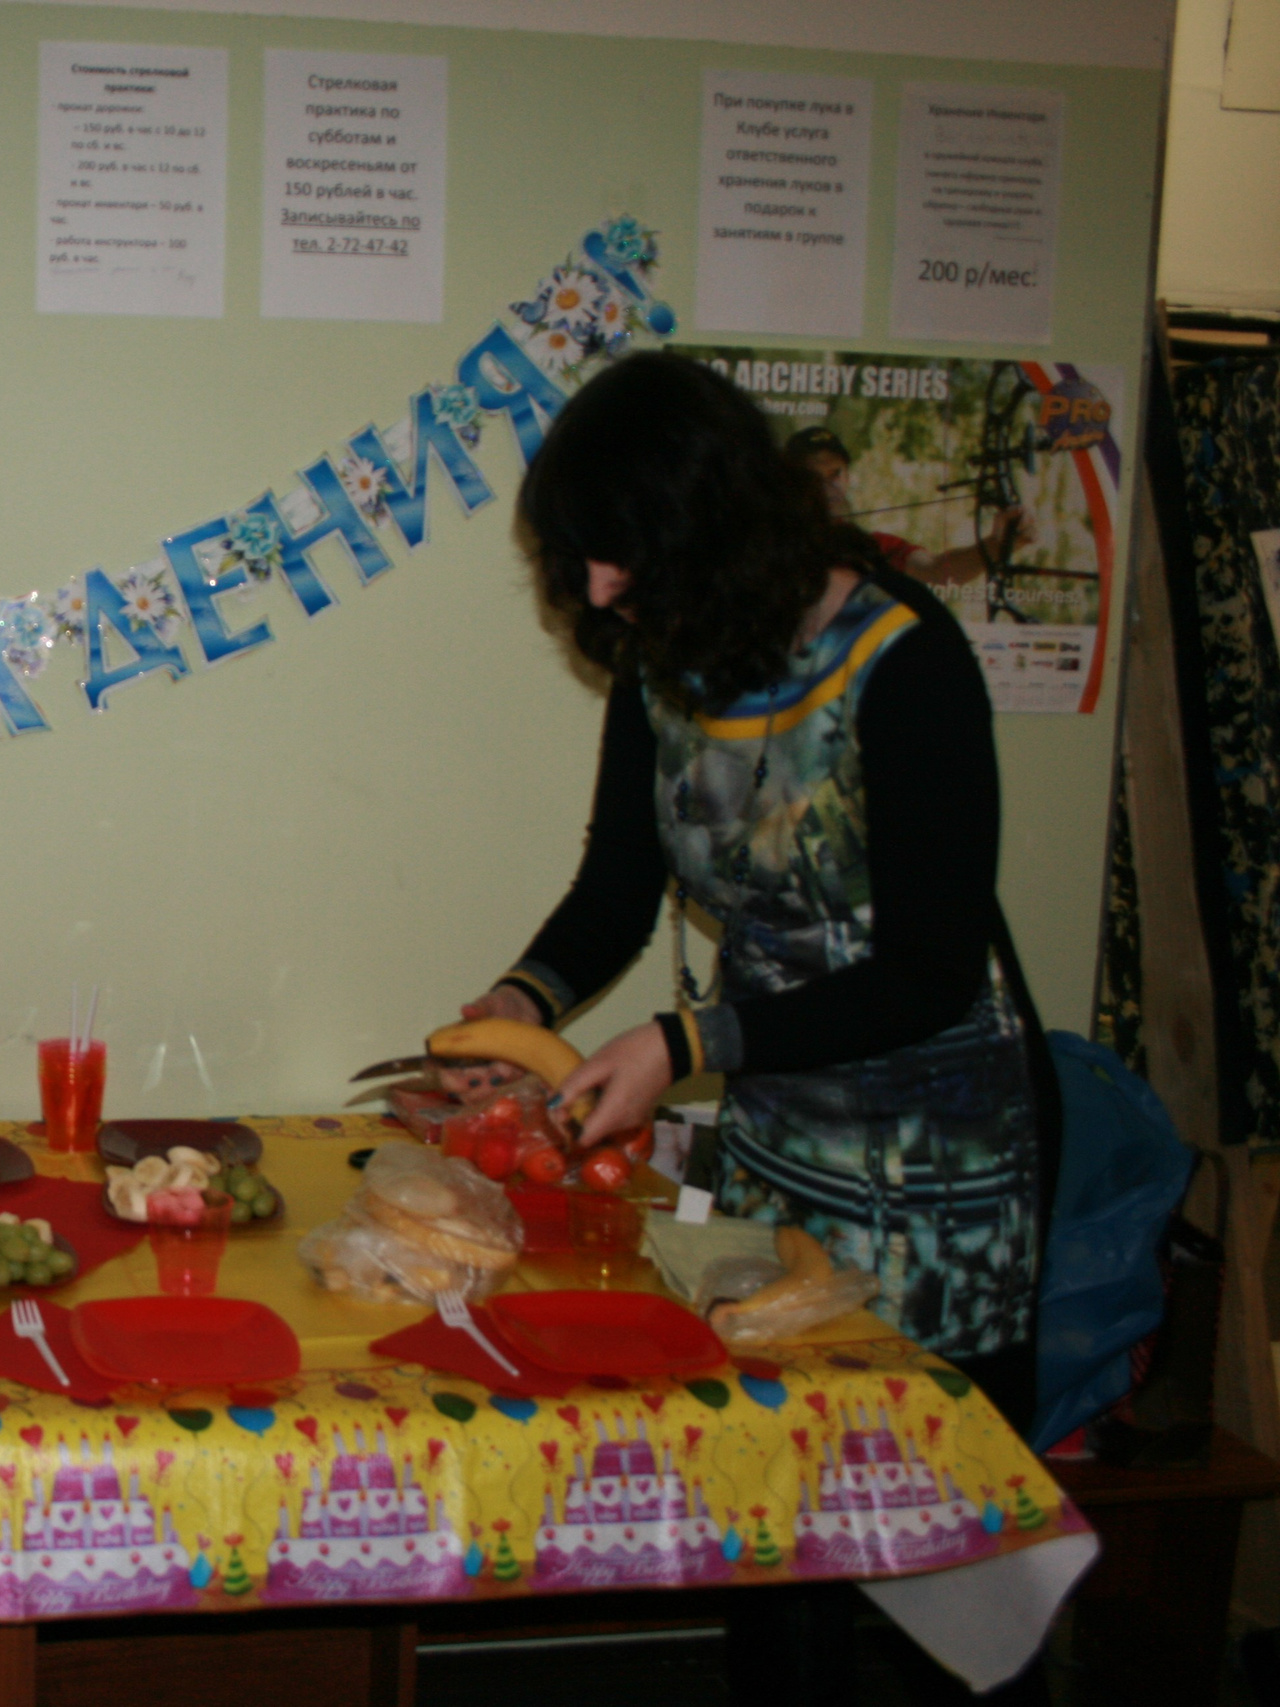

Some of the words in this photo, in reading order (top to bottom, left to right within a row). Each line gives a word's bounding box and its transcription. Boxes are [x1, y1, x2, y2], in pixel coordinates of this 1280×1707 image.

[307, 73, 399, 92] Стрелковая
[305, 103, 377, 119] практика
[381, 105, 401, 119] по
[713, 91, 743, 110] При
[745, 96, 807, 113] покупке
[810, 101, 842, 116] лука
[845, 104, 855, 115] в
[83, 123, 101, 133] 150
[193, 126, 206, 137] 12
[307, 128, 383, 147] субботам
[387, 134, 397, 146] и
[736, 120, 780, 138] Клубе
[784, 126, 830, 141] услуга
[78, 160, 96, 170] 200
[158, 162, 170, 172] 12
[285, 157, 396, 174] воскресеньям
[400, 161, 418, 174] от
[725, 148, 838, 167] ответственного
[285, 181, 312, 196] 150
[316, 182, 372, 200] рублей
[376, 188, 385, 199] в
[718, 174, 787, 189] хранения
[790, 178, 831, 194] луков
[834, 181, 844, 193] в
[280, 207, 399, 228] Записывайтесь
[401, 215, 421, 230] по
[743, 201, 805, 217] подарок
[326, 236, 409, 255] 2-72-47-42
[713, 226, 782, 241] занятиям
[785, 230, 794, 242] в
[796, 231, 845, 247] группе
[918, 258, 959, 283] 200
[734, 359, 857, 397] ARCHERY
[860, 367, 950, 402] SERIES
[756, 396, 828, 417] hery.com
[1038, 394, 1112, 427] PRO
